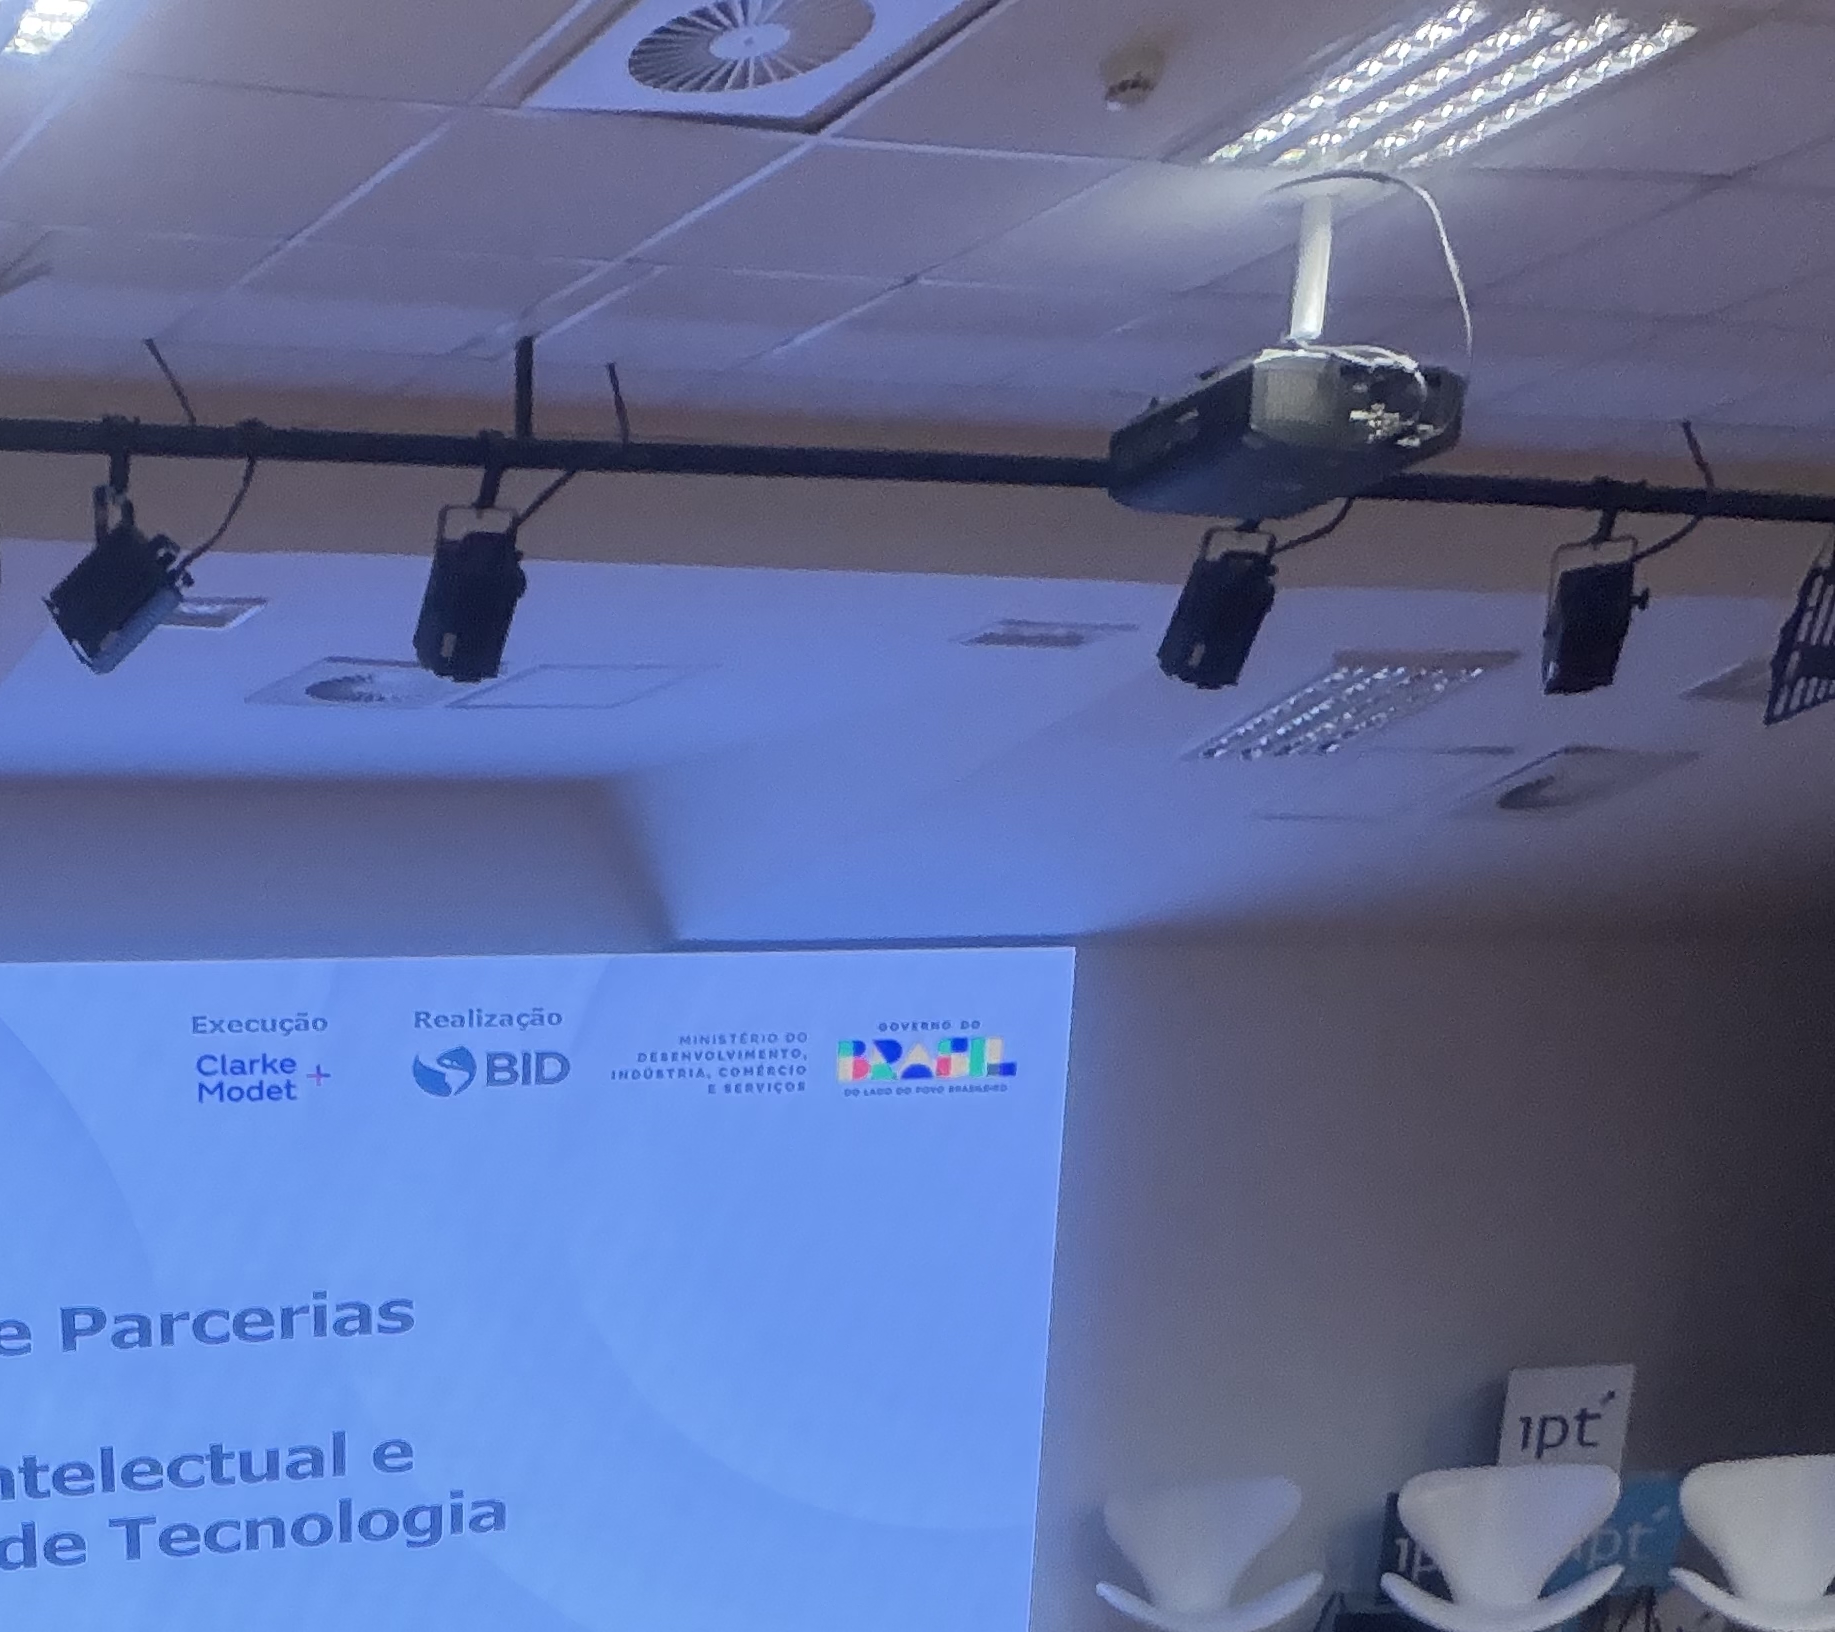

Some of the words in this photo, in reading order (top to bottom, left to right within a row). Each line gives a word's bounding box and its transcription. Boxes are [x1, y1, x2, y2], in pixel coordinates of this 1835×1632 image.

[191, 1012, 328, 1036] Execução
[413, 1008, 563, 1031] Realização
[678, 1032, 779, 1046] MINISTÉRIO
[785, 1031, 808, 1044] DO
[195, 1053, 297, 1078] Clarke
[485, 1050, 571, 1087] BID
[197, 1080, 298, 1103] Modet
[707, 1083, 717, 1094] E
[724, 1081, 805, 1095] SERVIÇOS
[58, 1290, 416, 1353] Parcerias
[372, 1438, 414, 1473] e
[109, 1489, 506, 1560] Tecnologia
